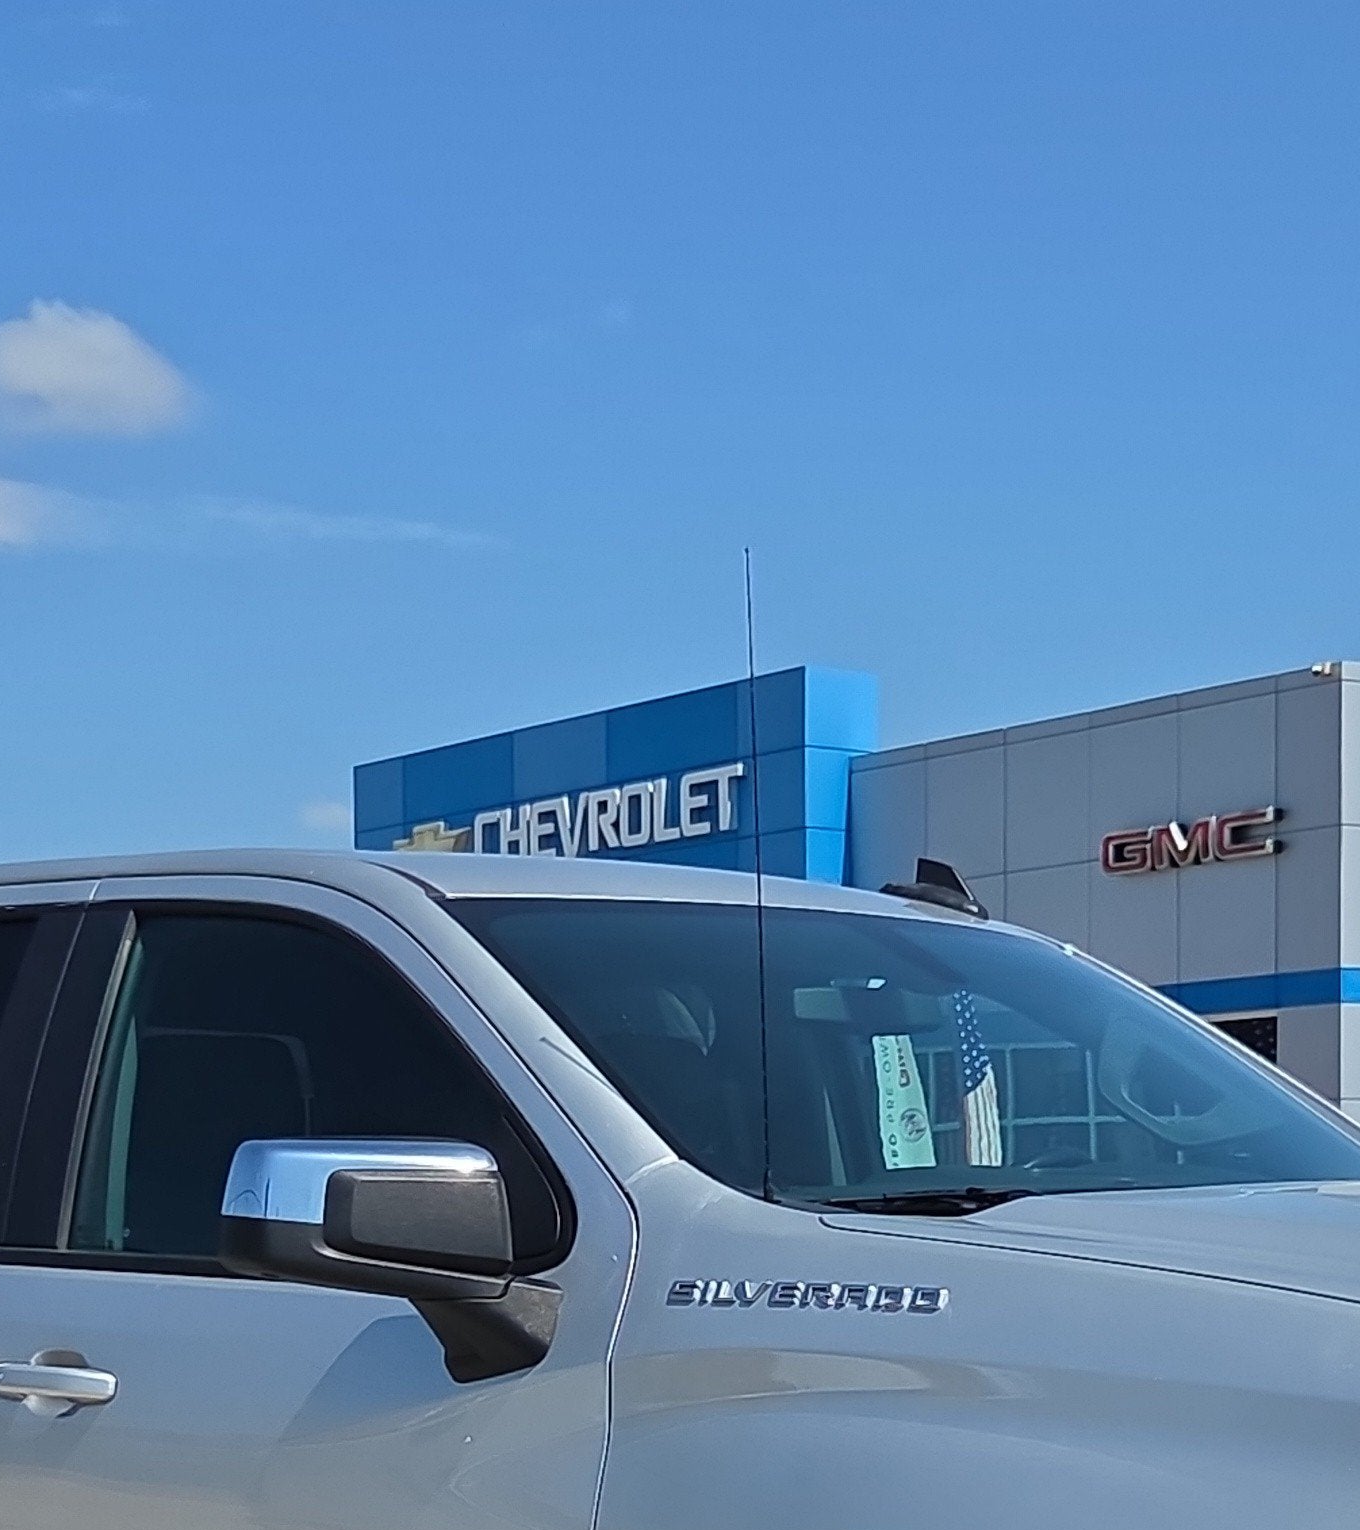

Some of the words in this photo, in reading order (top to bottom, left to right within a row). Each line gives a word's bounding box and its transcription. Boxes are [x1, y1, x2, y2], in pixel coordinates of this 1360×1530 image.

[474, 762, 744, 858] CHEVROLET
[1100, 804, 1277, 877] GMC
[665, 1279, 951, 1314] SILVERADO
